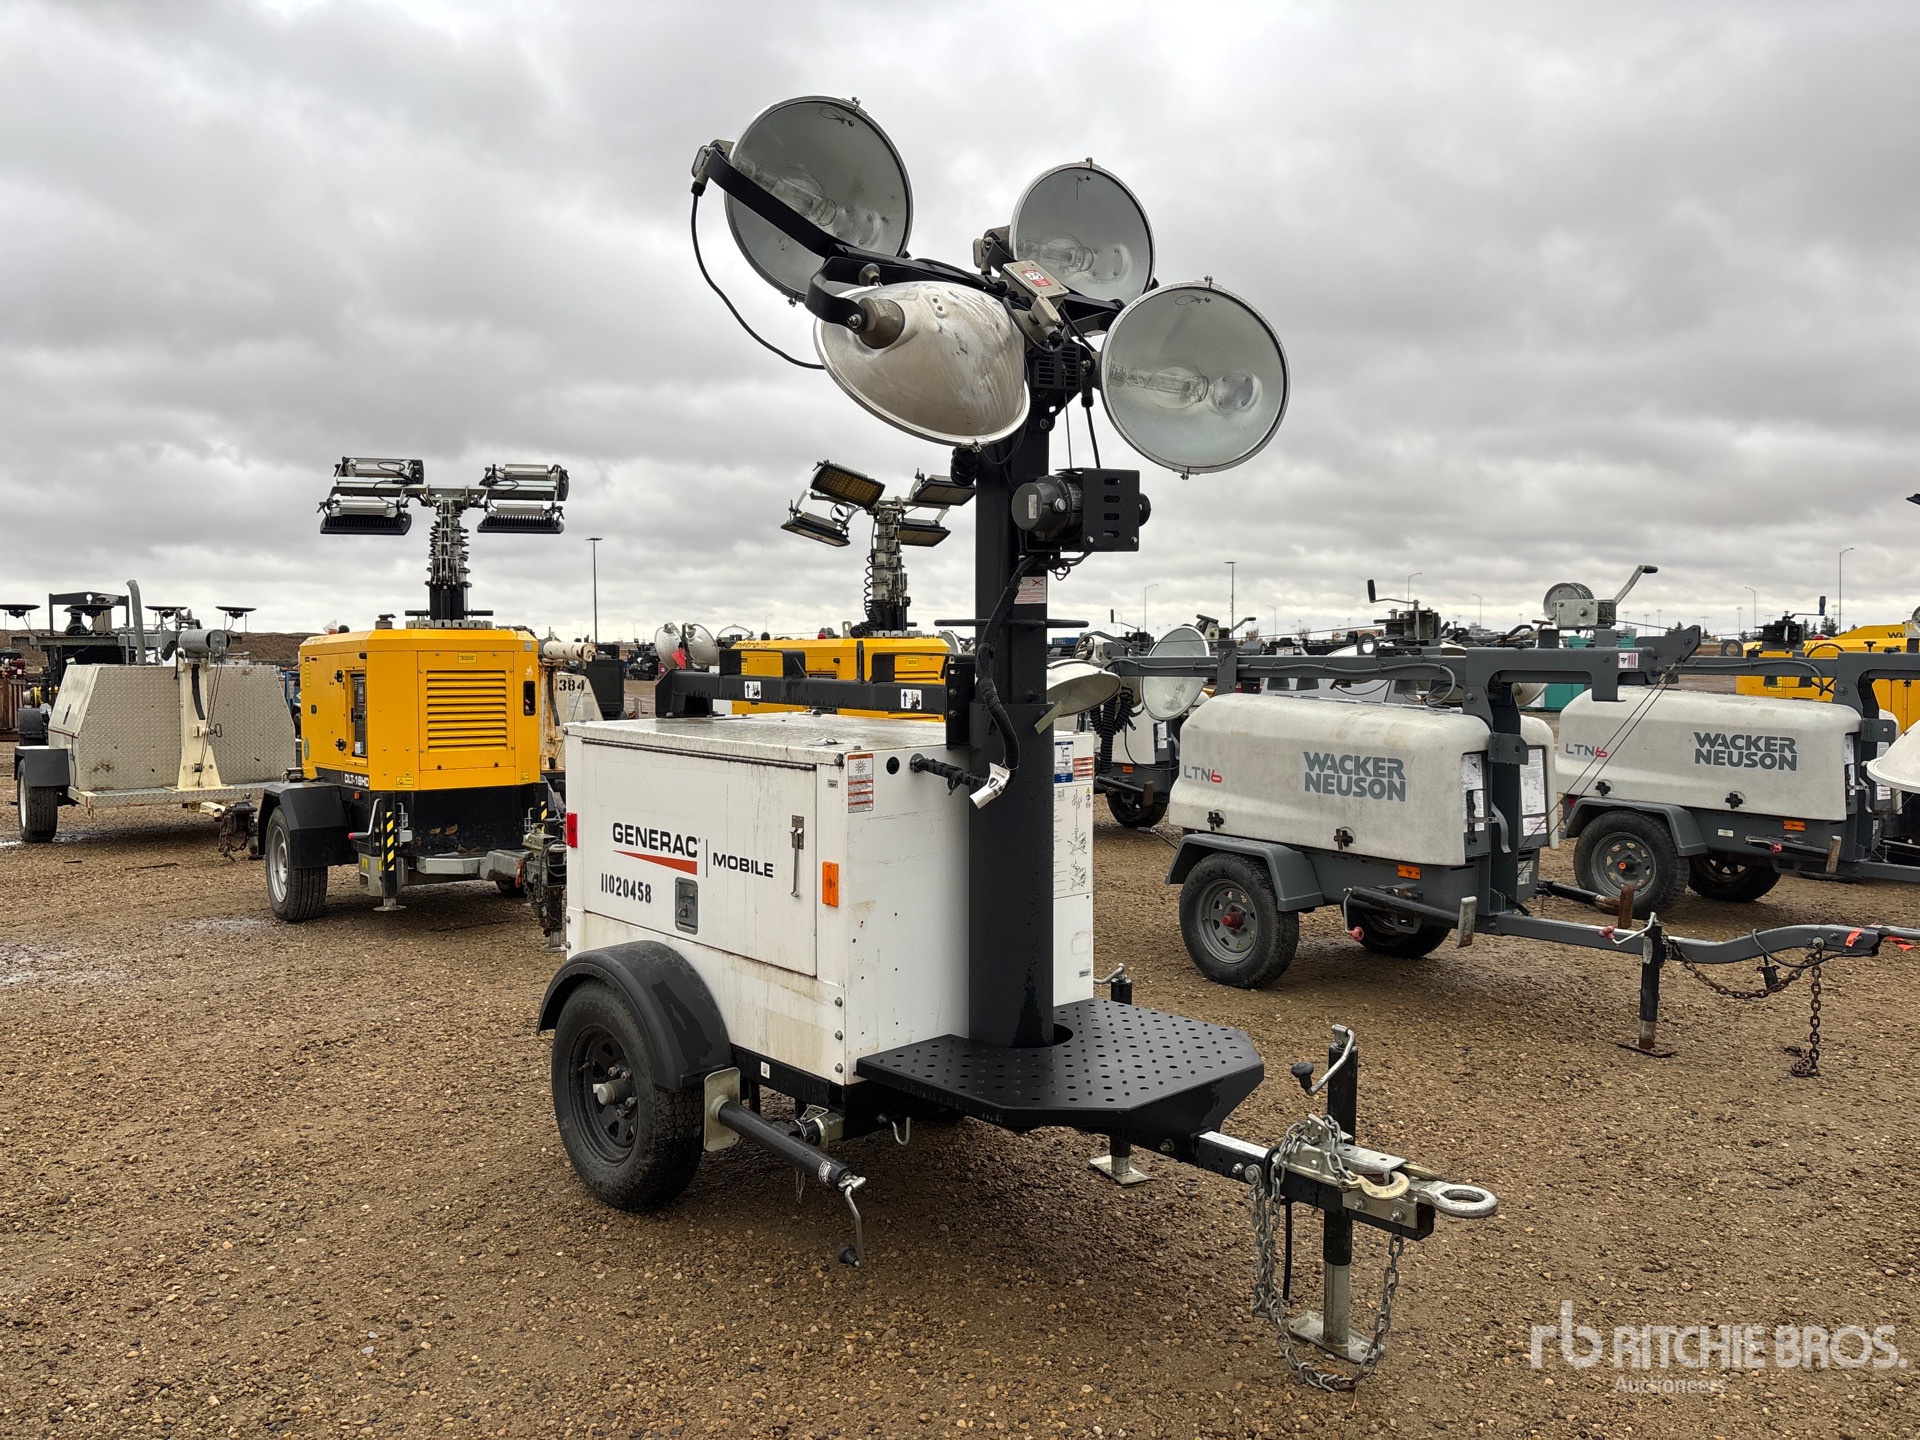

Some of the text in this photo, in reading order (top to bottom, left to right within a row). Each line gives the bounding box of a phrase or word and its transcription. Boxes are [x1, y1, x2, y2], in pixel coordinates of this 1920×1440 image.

[558, 679, 585, 691] 384
[1565, 742, 1608, 758] LTN6
[1693, 731, 1798, 754] WACKER
[1303, 751, 1406, 780] WACKER
[1694, 748, 1798, 772] NEUSON
[1183, 765, 1223, 784] LTN6
[1304, 773, 1406, 802] NEUSON
[612, 822, 774, 879] GENERAC MOBILE
[600, 872, 652, 904] 11020458
